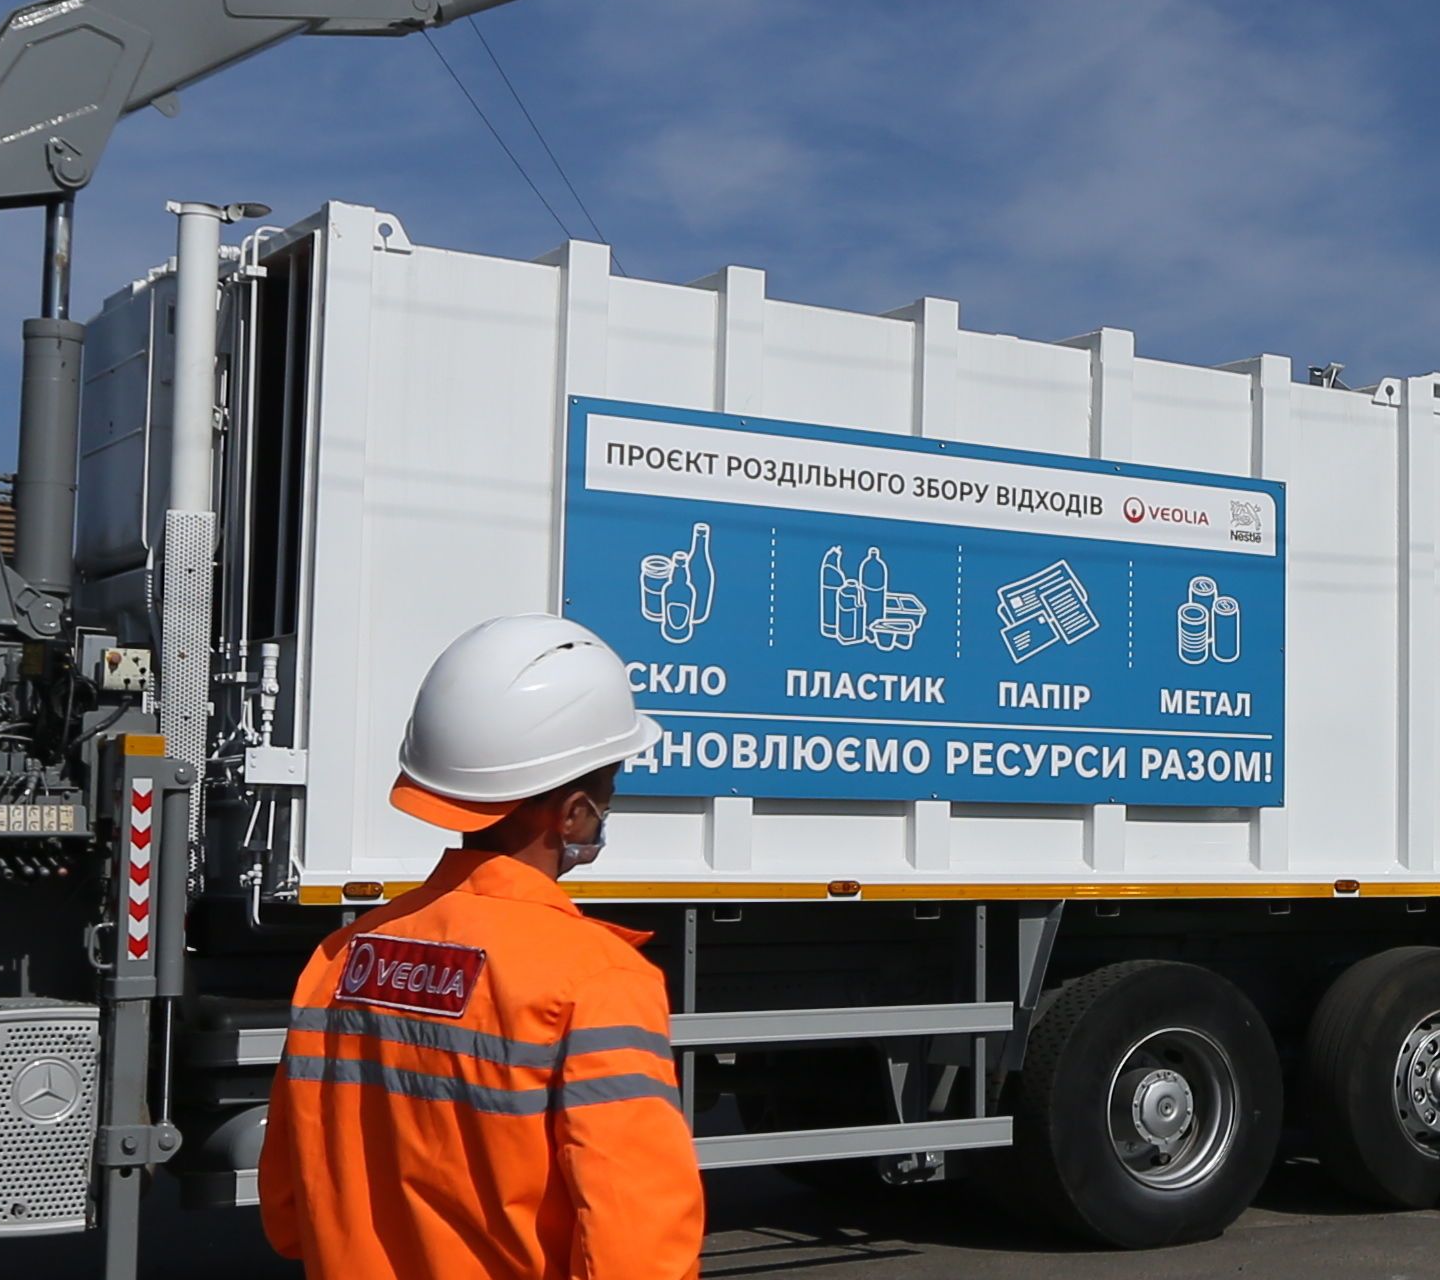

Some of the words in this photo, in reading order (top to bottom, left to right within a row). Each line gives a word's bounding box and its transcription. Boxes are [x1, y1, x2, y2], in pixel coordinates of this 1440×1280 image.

[606, 442, 719, 475] ПРОЄКТ
[727, 455, 906, 497] РОЗДІЛЬНОГО
[912, 476, 990, 504] ЗБОРУ
[997, 486, 1104, 516] ВІДХОДІВ
[1148, 505, 1210, 526] VEOLIA
[624, 662, 727, 696] СКЛО
[786, 669, 945, 704] ПЛАСТИК
[998, 681, 1092, 711] ПАПІР
[1160, 688, 1251, 718] МЕТАЛ
[946, 741, 1127, 779] РЕСУРСИ
[1141, 747, 1273, 783] РАЗОМ!
[377, 958, 464, 998] VEOLIA
